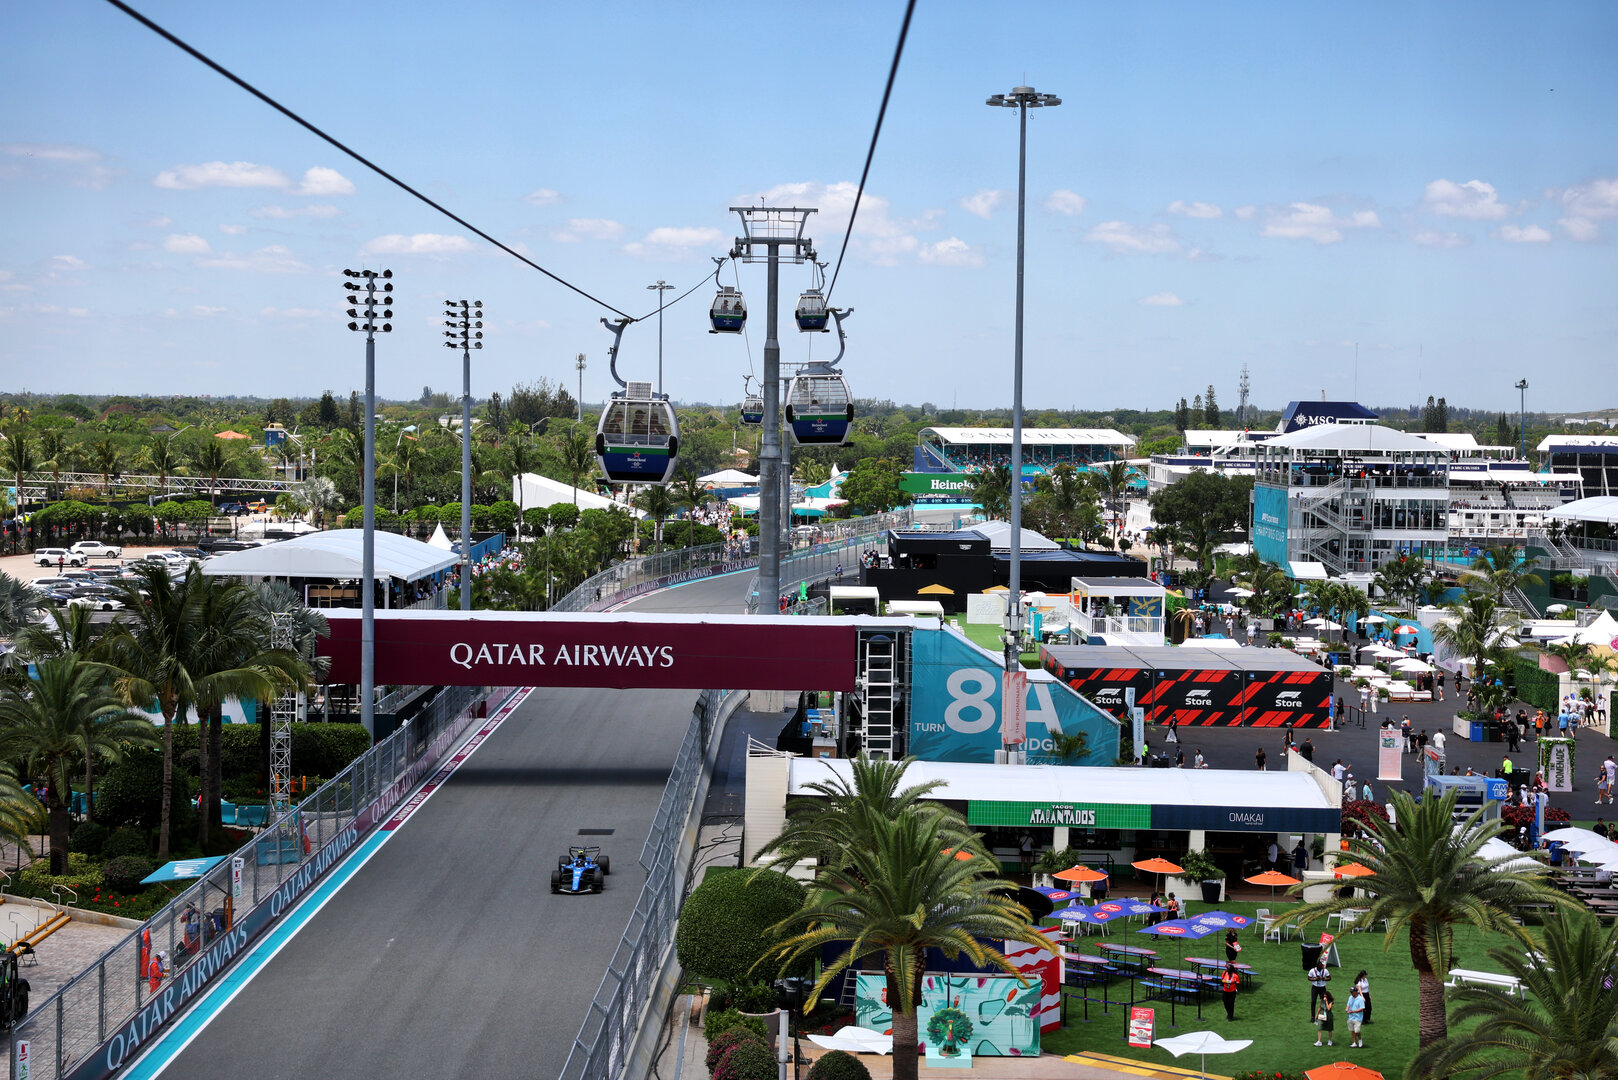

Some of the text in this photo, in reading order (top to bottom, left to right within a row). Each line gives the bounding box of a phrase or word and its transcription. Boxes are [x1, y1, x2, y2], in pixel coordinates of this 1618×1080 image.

[1308, 416, 1334, 424] MSC
[722, 562, 743, 573] QATAR
[668, 567, 712, 585] QATAR AIRWAYS
[450, 642, 674, 669] QATAR AIRWAYS
[1096, 697, 1122, 705] Store
[1185, 698, 1212, 706] Store
[1275, 699, 1302, 708] Store
[915, 722, 945, 732] TURN
[435, 732, 454, 759] QATAR
[1556, 748, 1564, 787] PROMENADE
[371, 784, 400, 823] QATAR
[1030, 809, 1095, 825] ATARANTADOS
[1229, 813, 1263, 822] OMAKAI
[271, 821, 358, 917] QATAR AIRWAYS
[106, 920, 247, 1070] QATAR AIRWAYS
